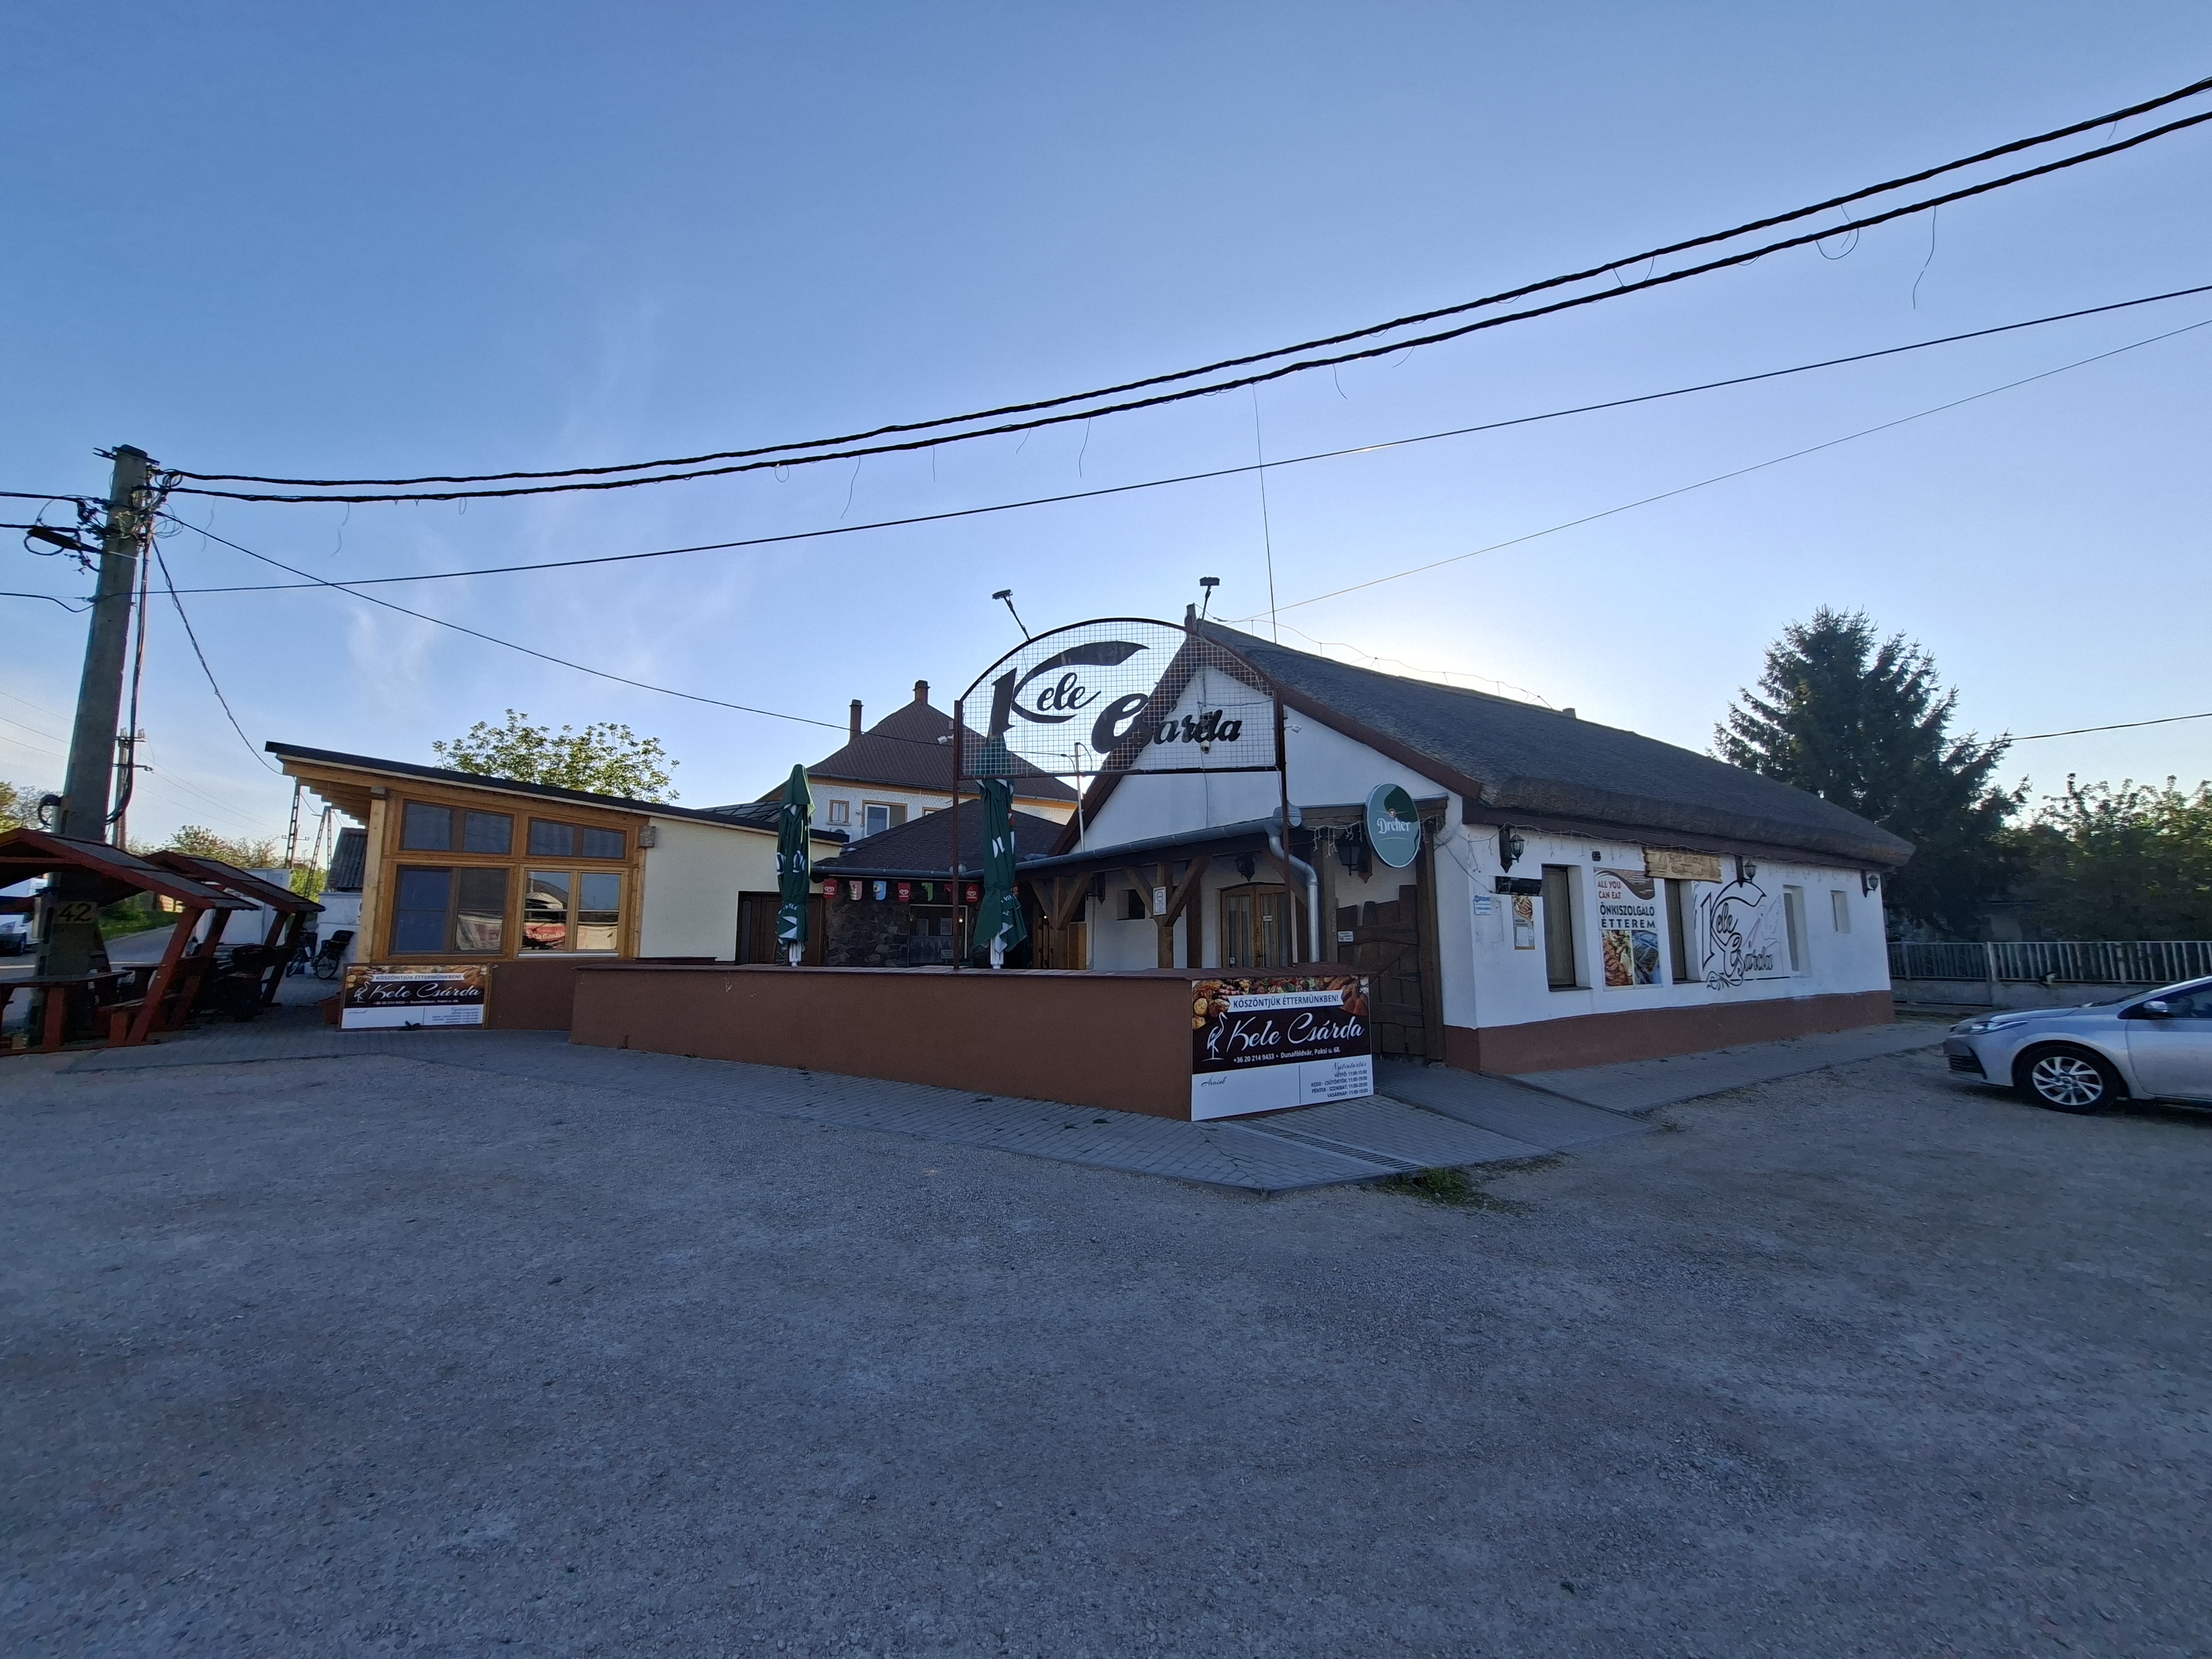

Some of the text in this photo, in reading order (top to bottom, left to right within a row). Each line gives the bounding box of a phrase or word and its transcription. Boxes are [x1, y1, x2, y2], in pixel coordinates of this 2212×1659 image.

[985, 640, 1150, 747] Kele
[1376, 817, 1411, 834] Dreher
[1597, 880, 1621, 889] ALL YOU
[1598, 891, 1621, 900] CAN EAT
[59, 902, 91, 922] 42
[1601, 916, 1656, 928] ÉTTEREM
[368, 983, 483, 1000] Kele Csárda
[1233, 994, 1339, 1008] KÖSZÖNTJÜK ÉTTERMÜNKBEN!
[1226, 1012, 1365, 1052] Kele Csárda
[1281, 1049, 1313, 1058] Dunaföldvár,
